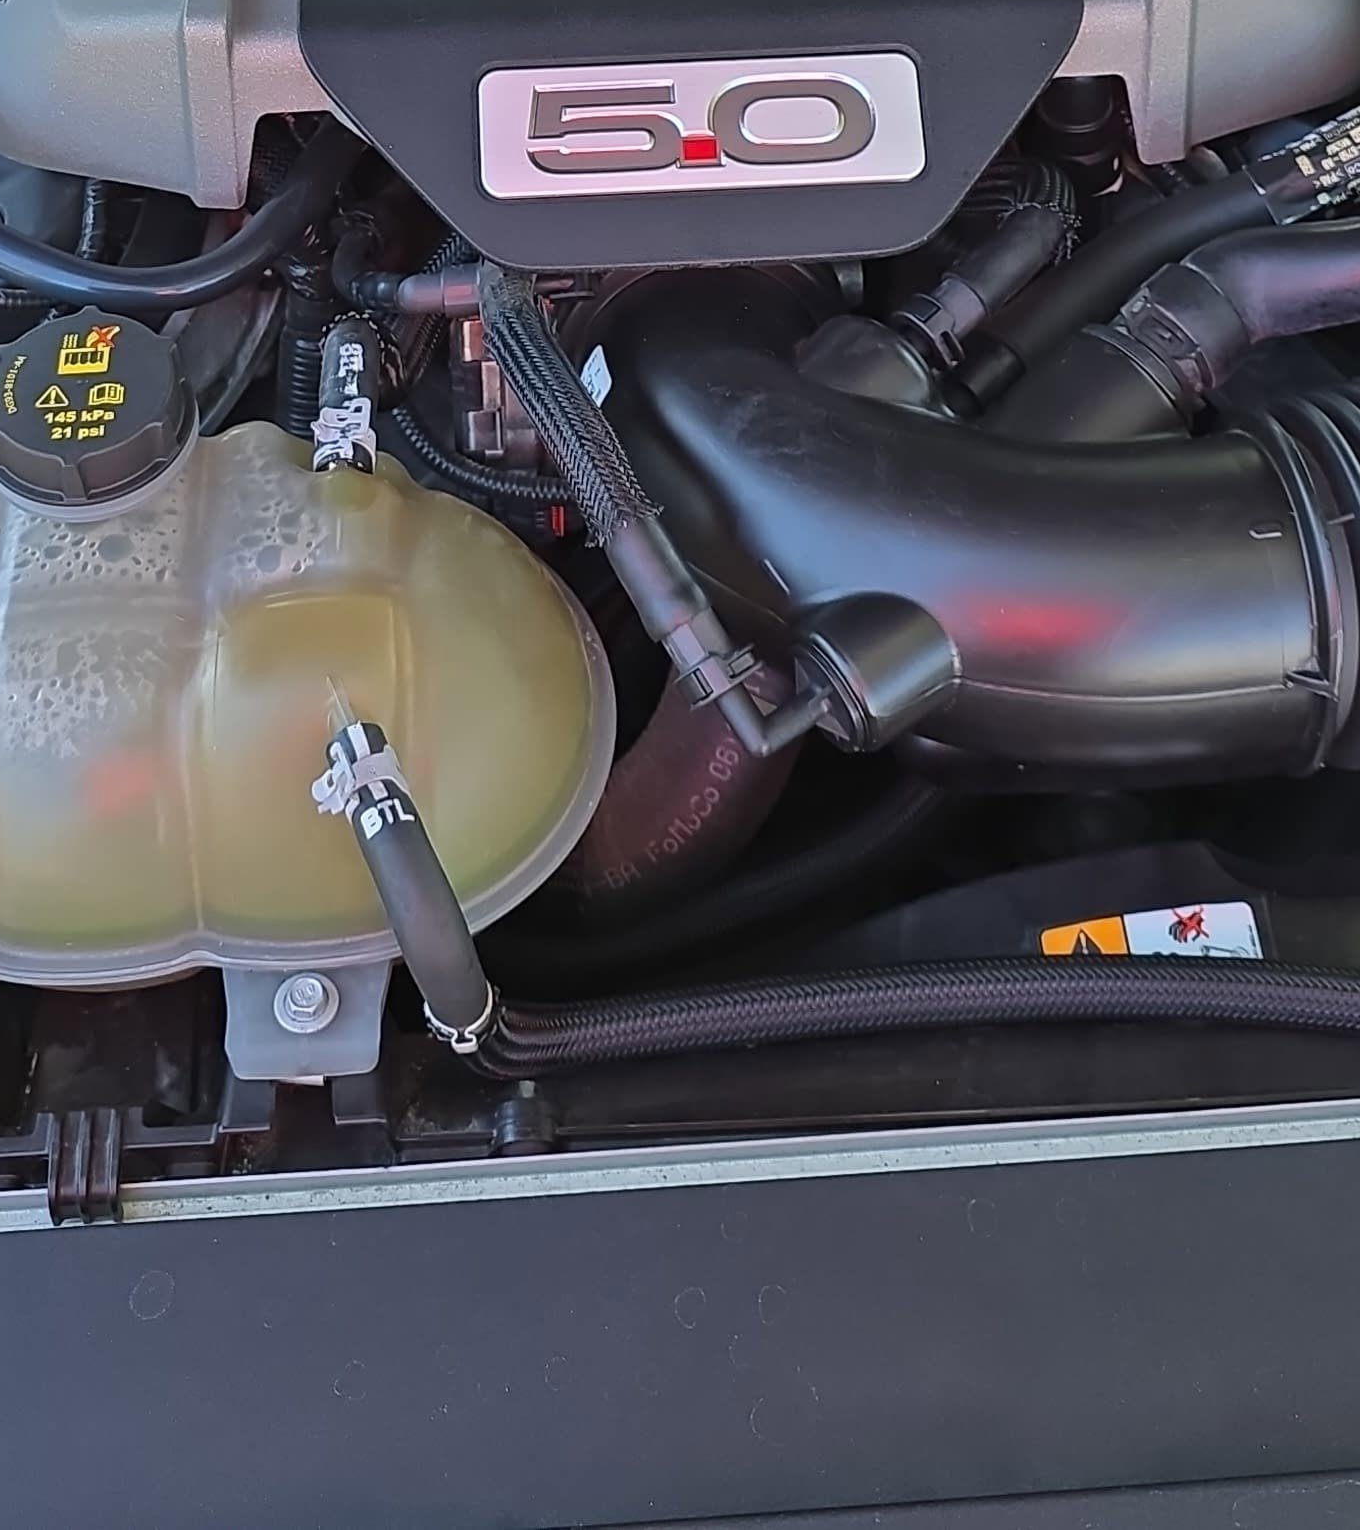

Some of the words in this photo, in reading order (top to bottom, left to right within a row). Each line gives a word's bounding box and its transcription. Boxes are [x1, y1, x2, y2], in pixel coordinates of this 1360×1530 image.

[527, 70, 877, 174] 5.0
[43, 410, 77, 424] 145
[80, 409, 115, 422] kPa
[50, 427, 72, 440] 21
[78, 425, 105, 440] psi
[360, 797, 416, 841] BTL
